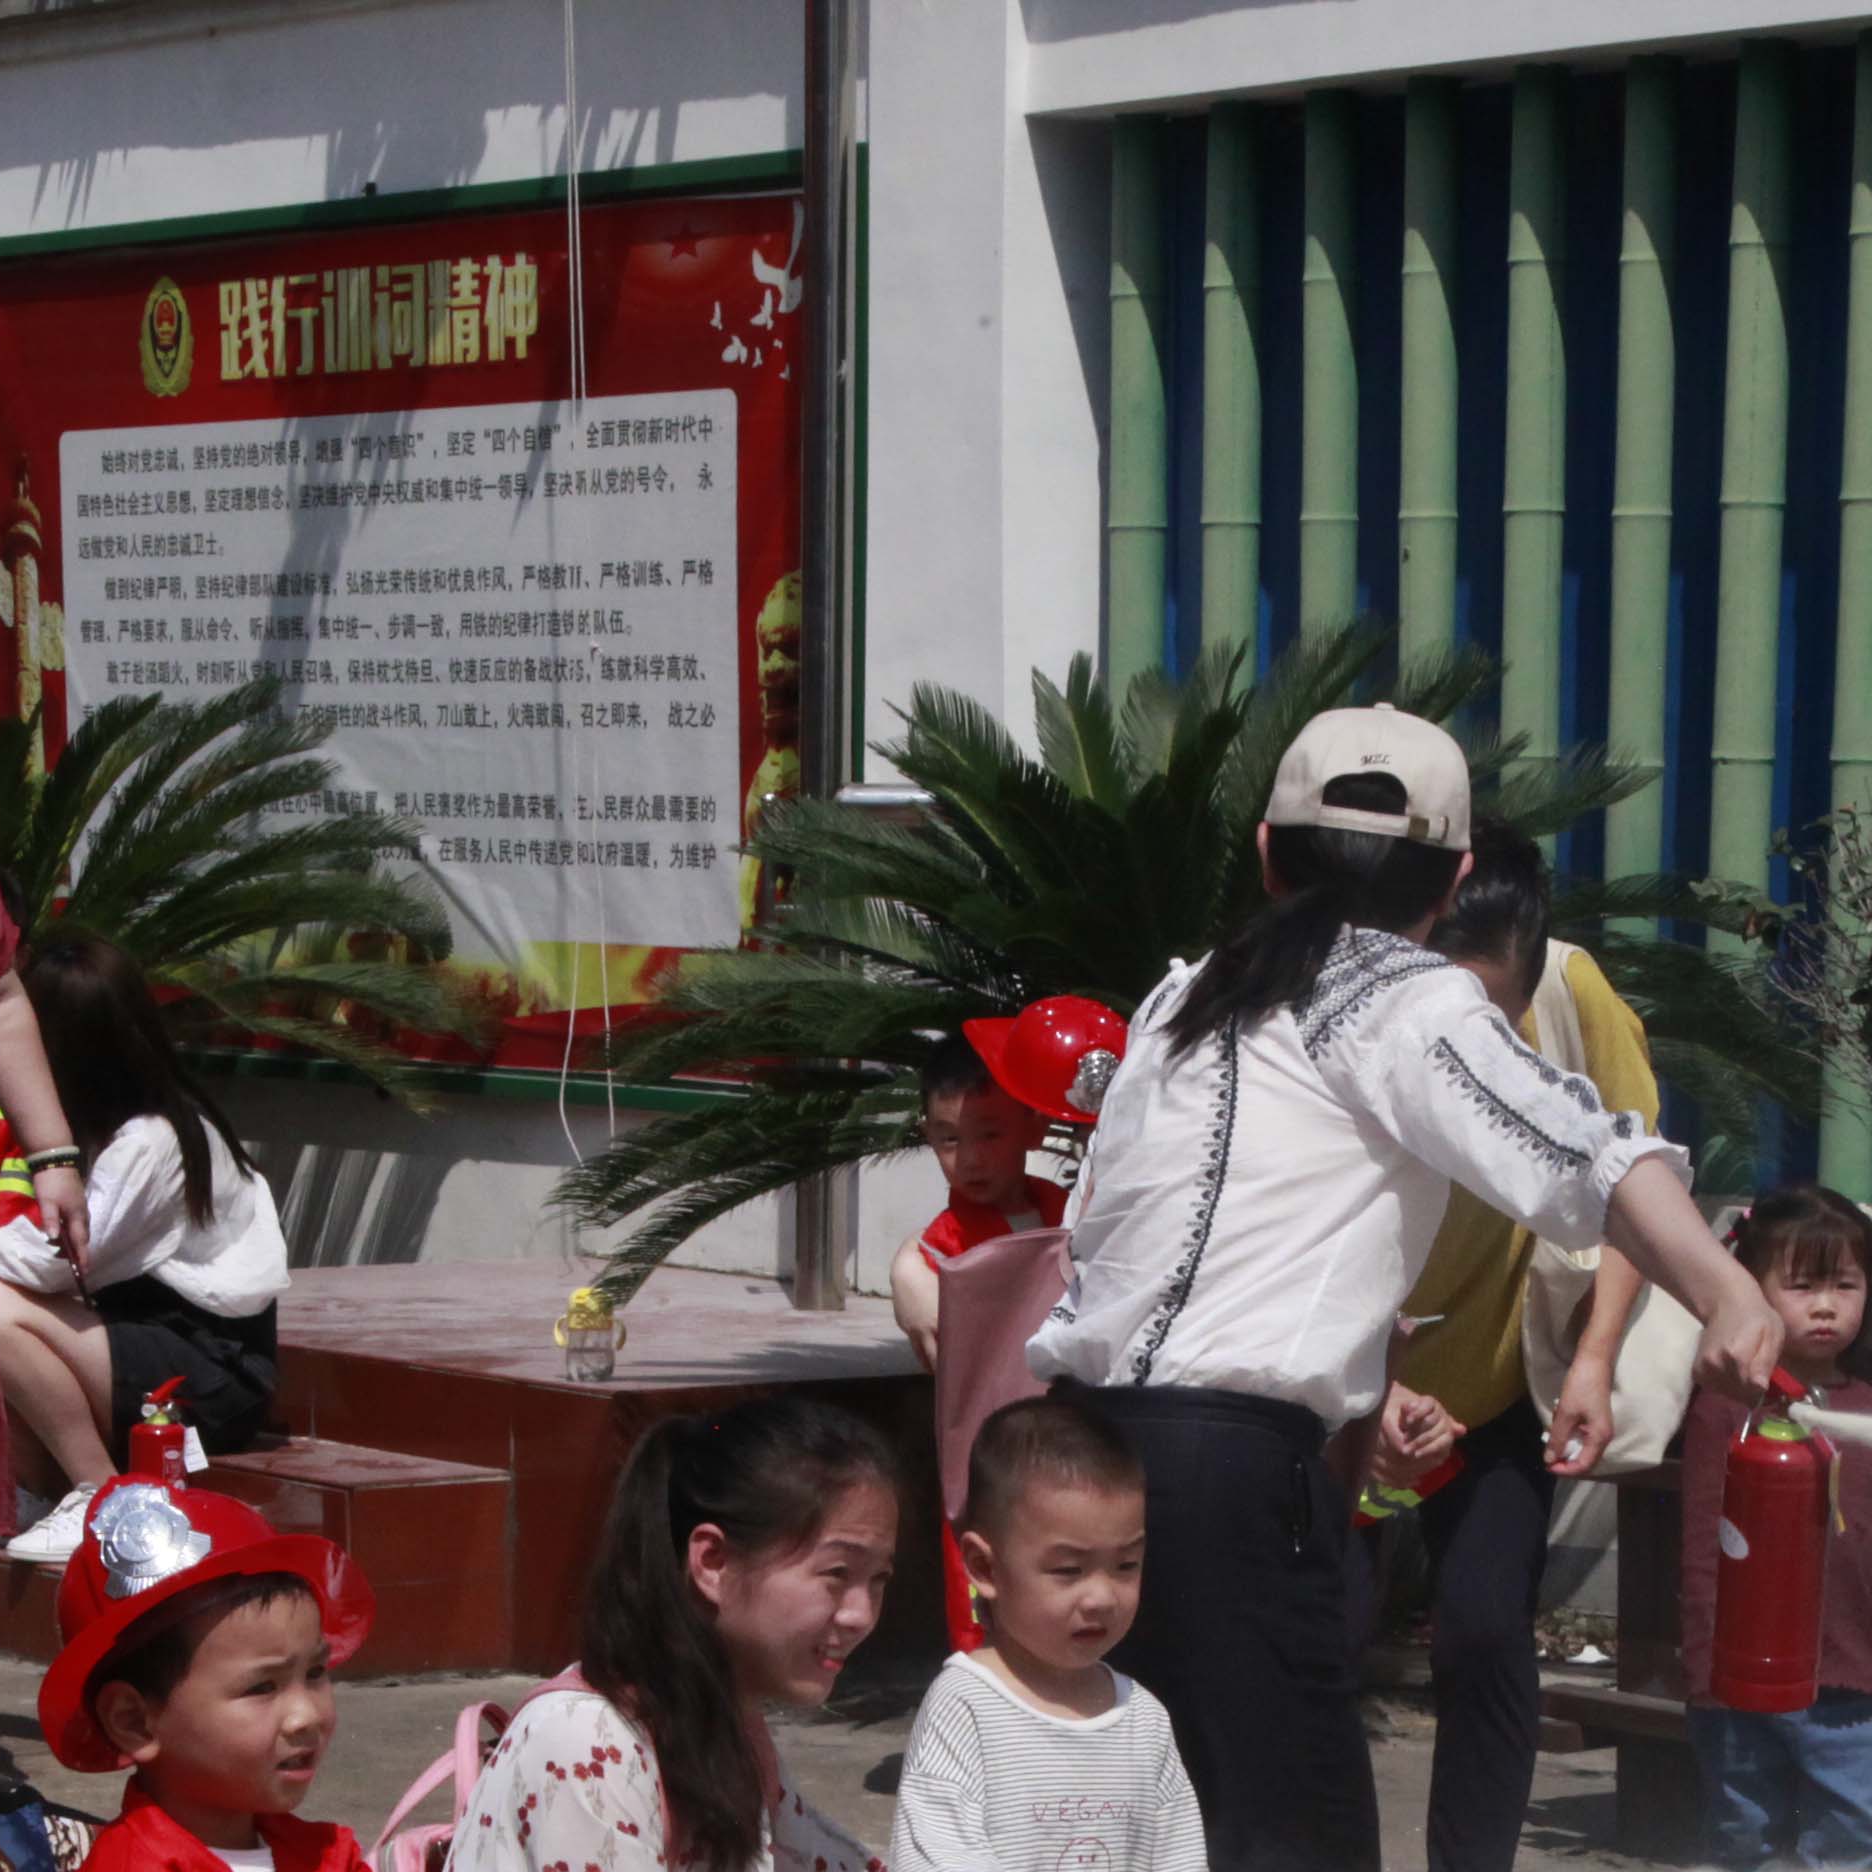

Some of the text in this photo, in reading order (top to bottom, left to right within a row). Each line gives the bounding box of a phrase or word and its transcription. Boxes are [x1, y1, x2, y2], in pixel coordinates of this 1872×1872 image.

[218, 252, 540, 381] 践行训词精神
[1032, 1798, 1136, 1822] VEGAN
